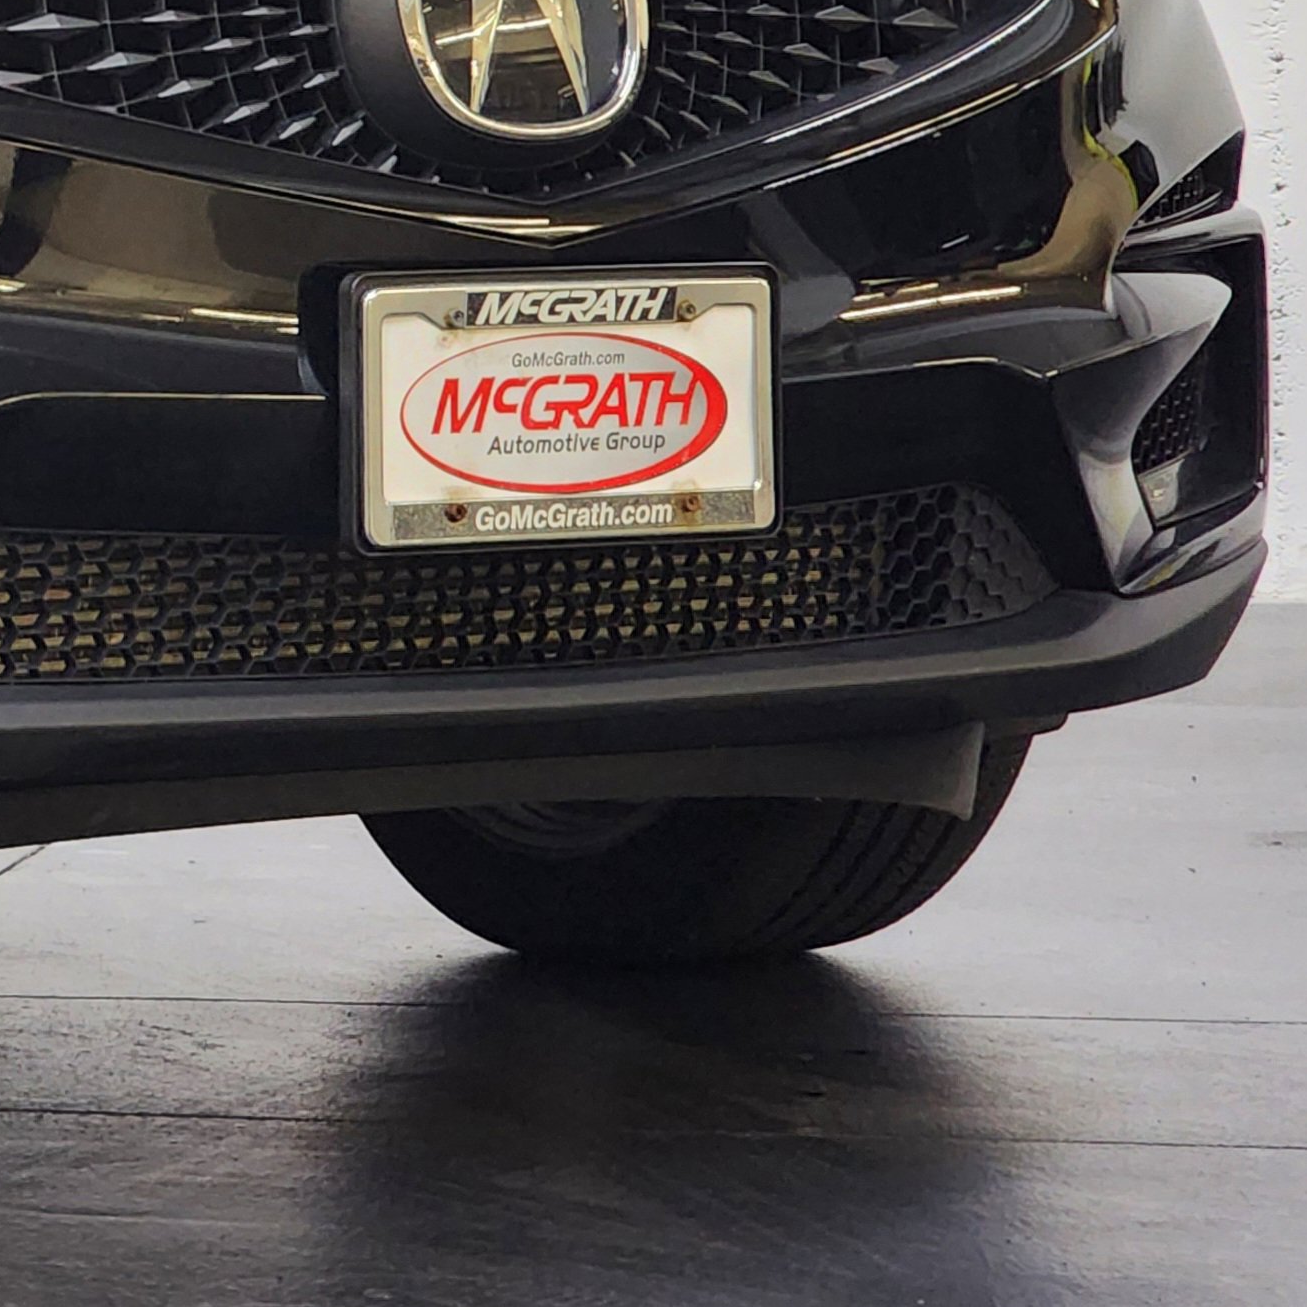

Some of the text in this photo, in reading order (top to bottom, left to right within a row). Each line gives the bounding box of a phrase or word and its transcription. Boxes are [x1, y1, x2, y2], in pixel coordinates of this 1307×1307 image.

[511, 351, 625, 369] GoMcGrath.com
[487, 431, 666, 455] Automotive Group
[474, 500, 673, 531] GoMcGrath.com
